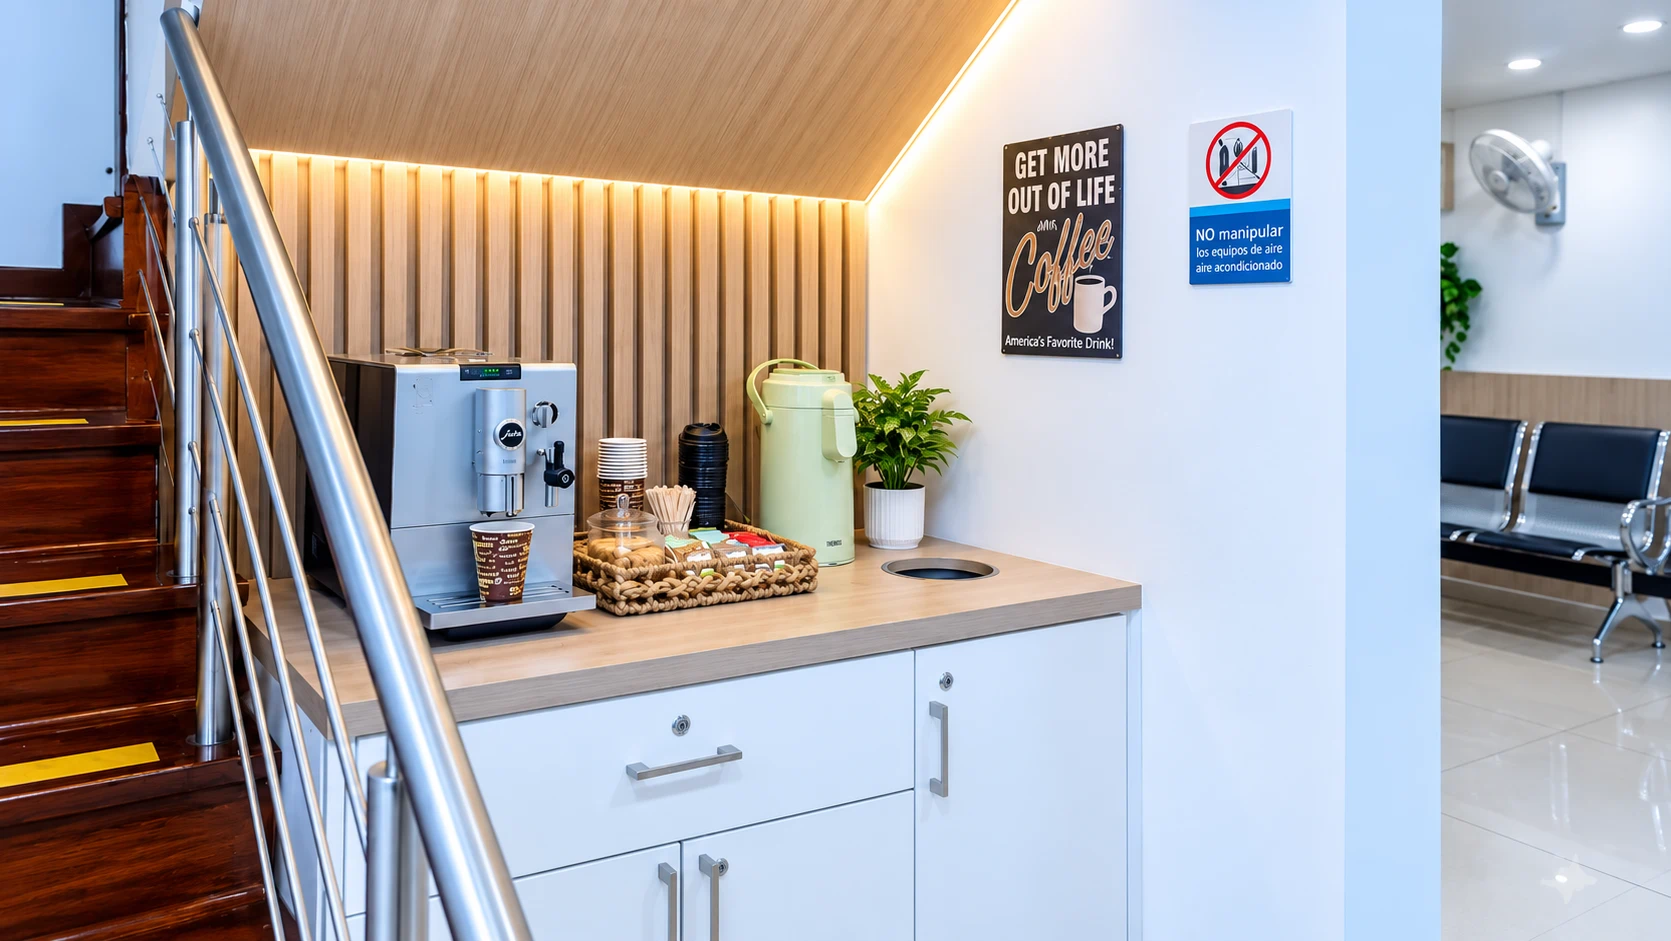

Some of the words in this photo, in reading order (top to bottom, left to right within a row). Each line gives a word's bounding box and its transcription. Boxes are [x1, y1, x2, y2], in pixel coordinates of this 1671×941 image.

[1015, 149, 1047, 179] GET
[1054, 138, 1109, 174] MORE
[1008, 185, 1042, 215] OUT
[1048, 181, 1071, 210] OF
[1077, 175, 1115, 207] LIFE
[1196, 228, 1215, 241] NO
[1219, 224, 1284, 242] manipular
[1196, 247, 1209, 258] los
[1211, 245, 1248, 259] equipos
[1251, 244, 1262, 255] de
[1265, 243, 1283, 254] aire
[1005, 212, 1115, 316] Coffee
[1196, 262, 1212, 273] aire
[1214, 259, 1283, 272] acondicionado
[1005, 335, 1045, 347] America's
[1047, 336, 1083, 349] Favorite
[1086, 337, 1114, 350] Drink!
